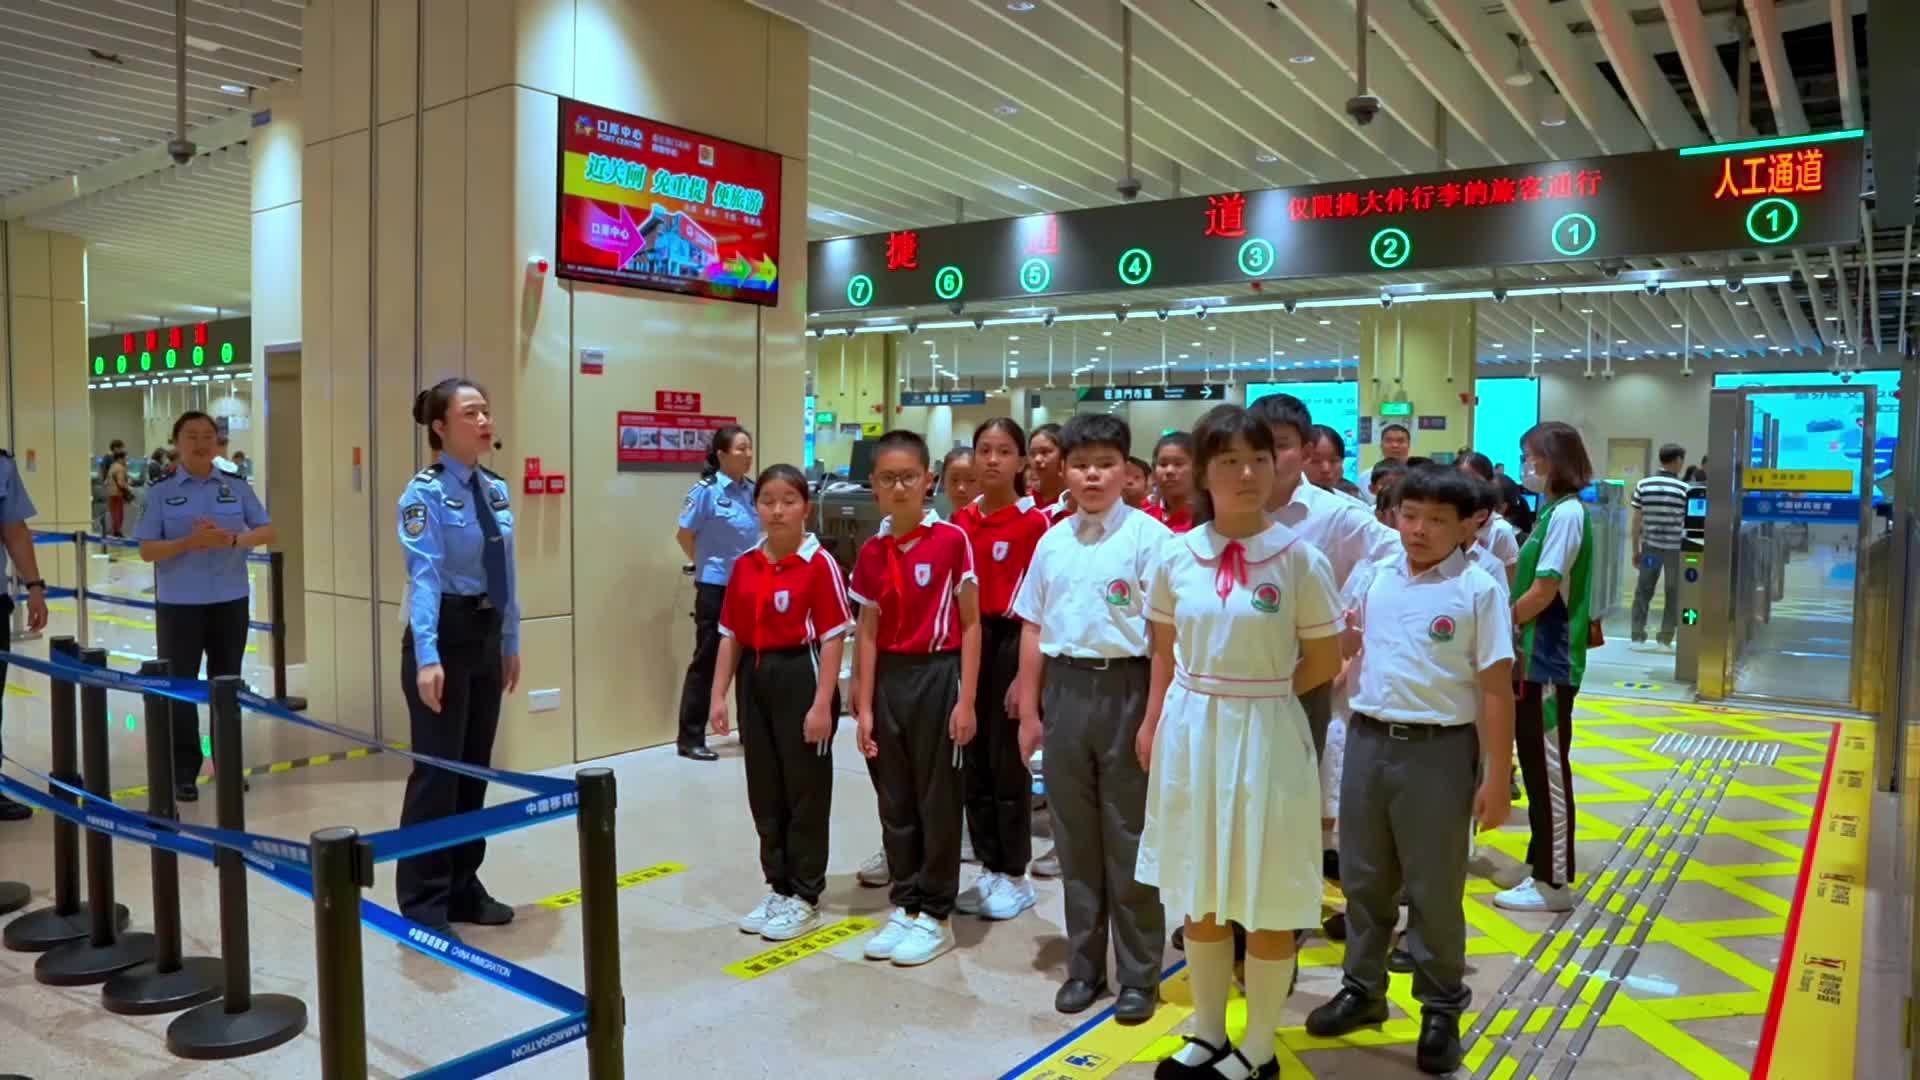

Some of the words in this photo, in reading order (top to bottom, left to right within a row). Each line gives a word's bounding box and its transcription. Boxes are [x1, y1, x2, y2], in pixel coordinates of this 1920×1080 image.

[597, 120, 643, 141] 口岸中心
[651, 168, 708, 203] 免重提
[712, 181, 765, 216] 便旅游
[1714, 149, 1824, 199] 人工通道
[886, 231, 919, 271] 捷
[1205, 193, 1248, 237] 道
[525, 791, 579, 815] 中国移民
